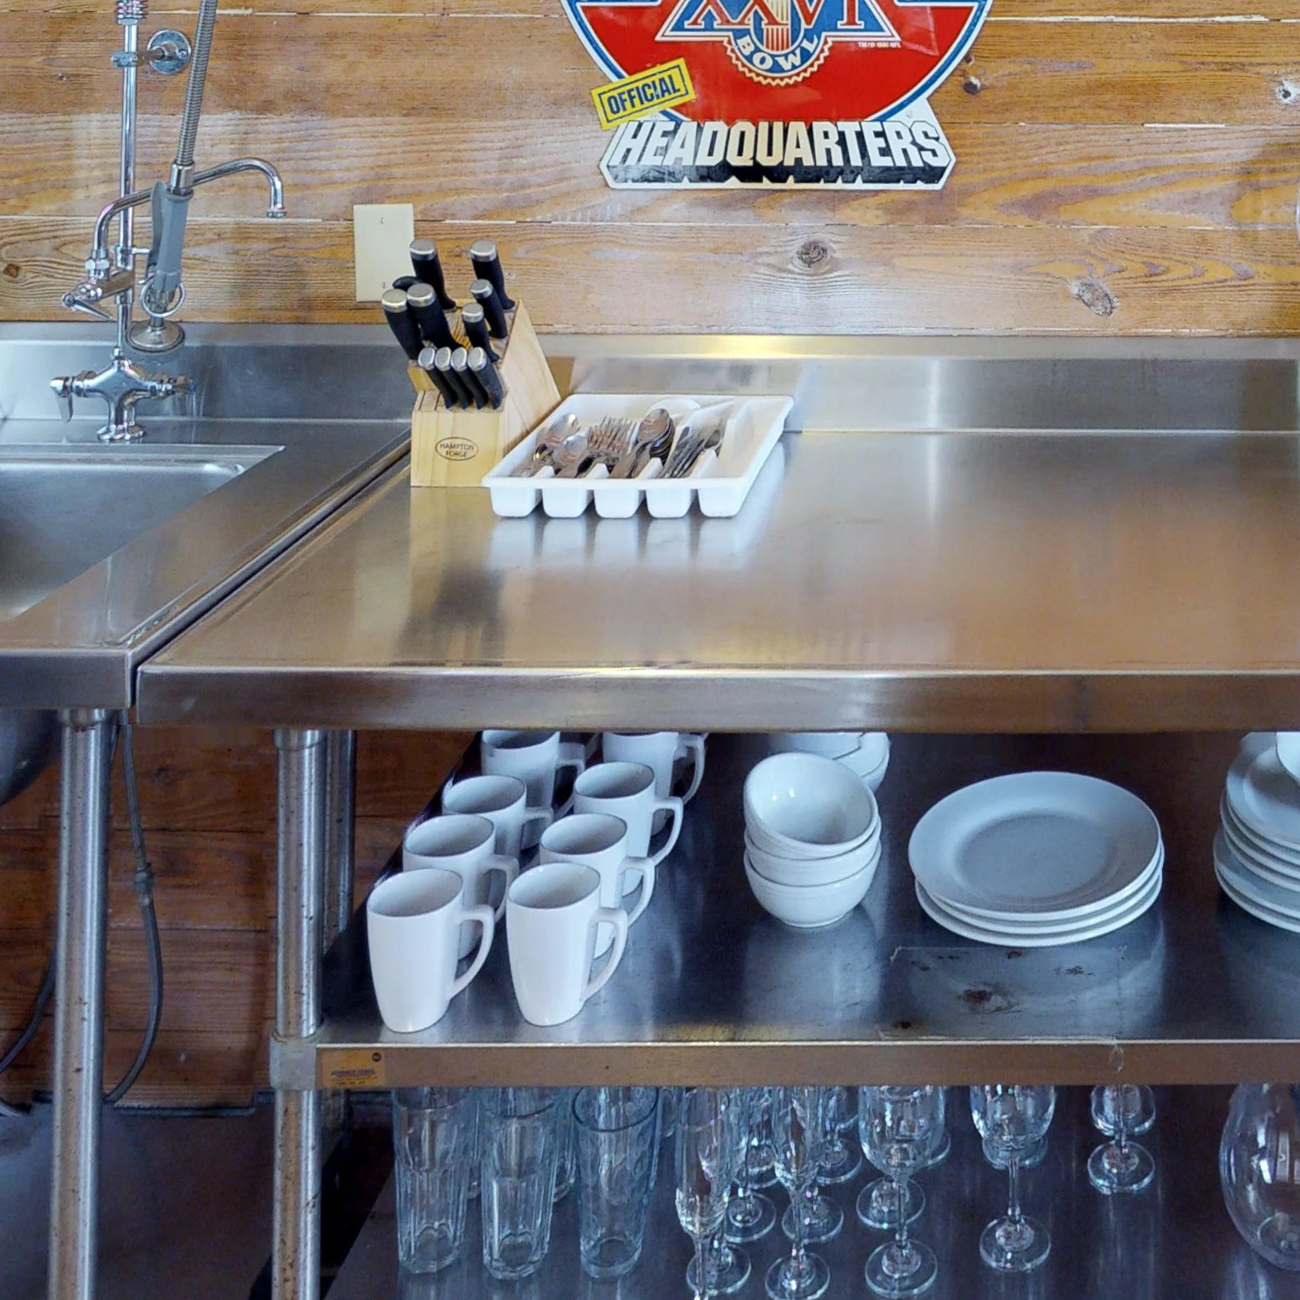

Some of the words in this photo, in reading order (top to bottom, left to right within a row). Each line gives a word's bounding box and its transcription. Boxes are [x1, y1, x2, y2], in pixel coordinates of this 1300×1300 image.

[736, 34, 819, 71] BOWL
[606, 73, 681, 119] OFFICIAL
[607, 119, 948, 174] HEADQUARTERS
